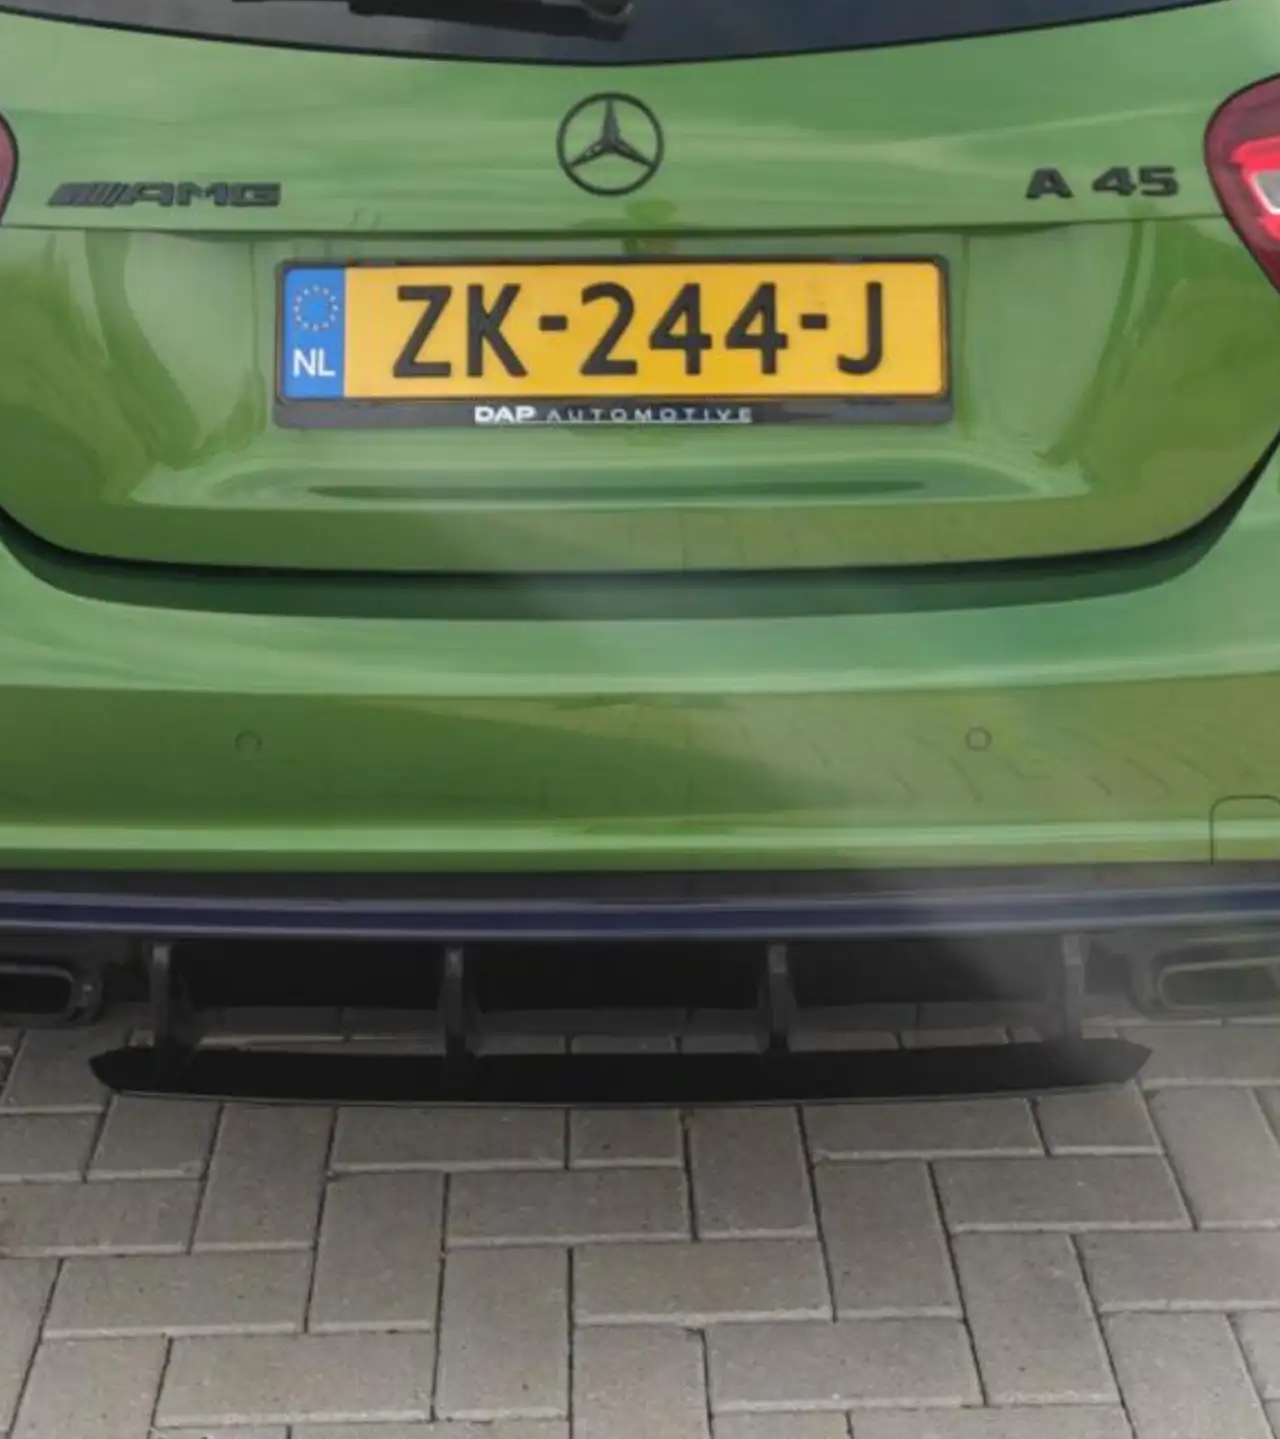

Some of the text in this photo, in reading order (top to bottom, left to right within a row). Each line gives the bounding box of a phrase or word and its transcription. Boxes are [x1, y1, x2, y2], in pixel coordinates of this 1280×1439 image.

[1025, 165, 1179, 199] A 45
[391, 280, 884, 379] ZK-244-J
[293, 349, 335, 378] NL
[474, 405, 753, 425] DAP AUTOMOTIVE
